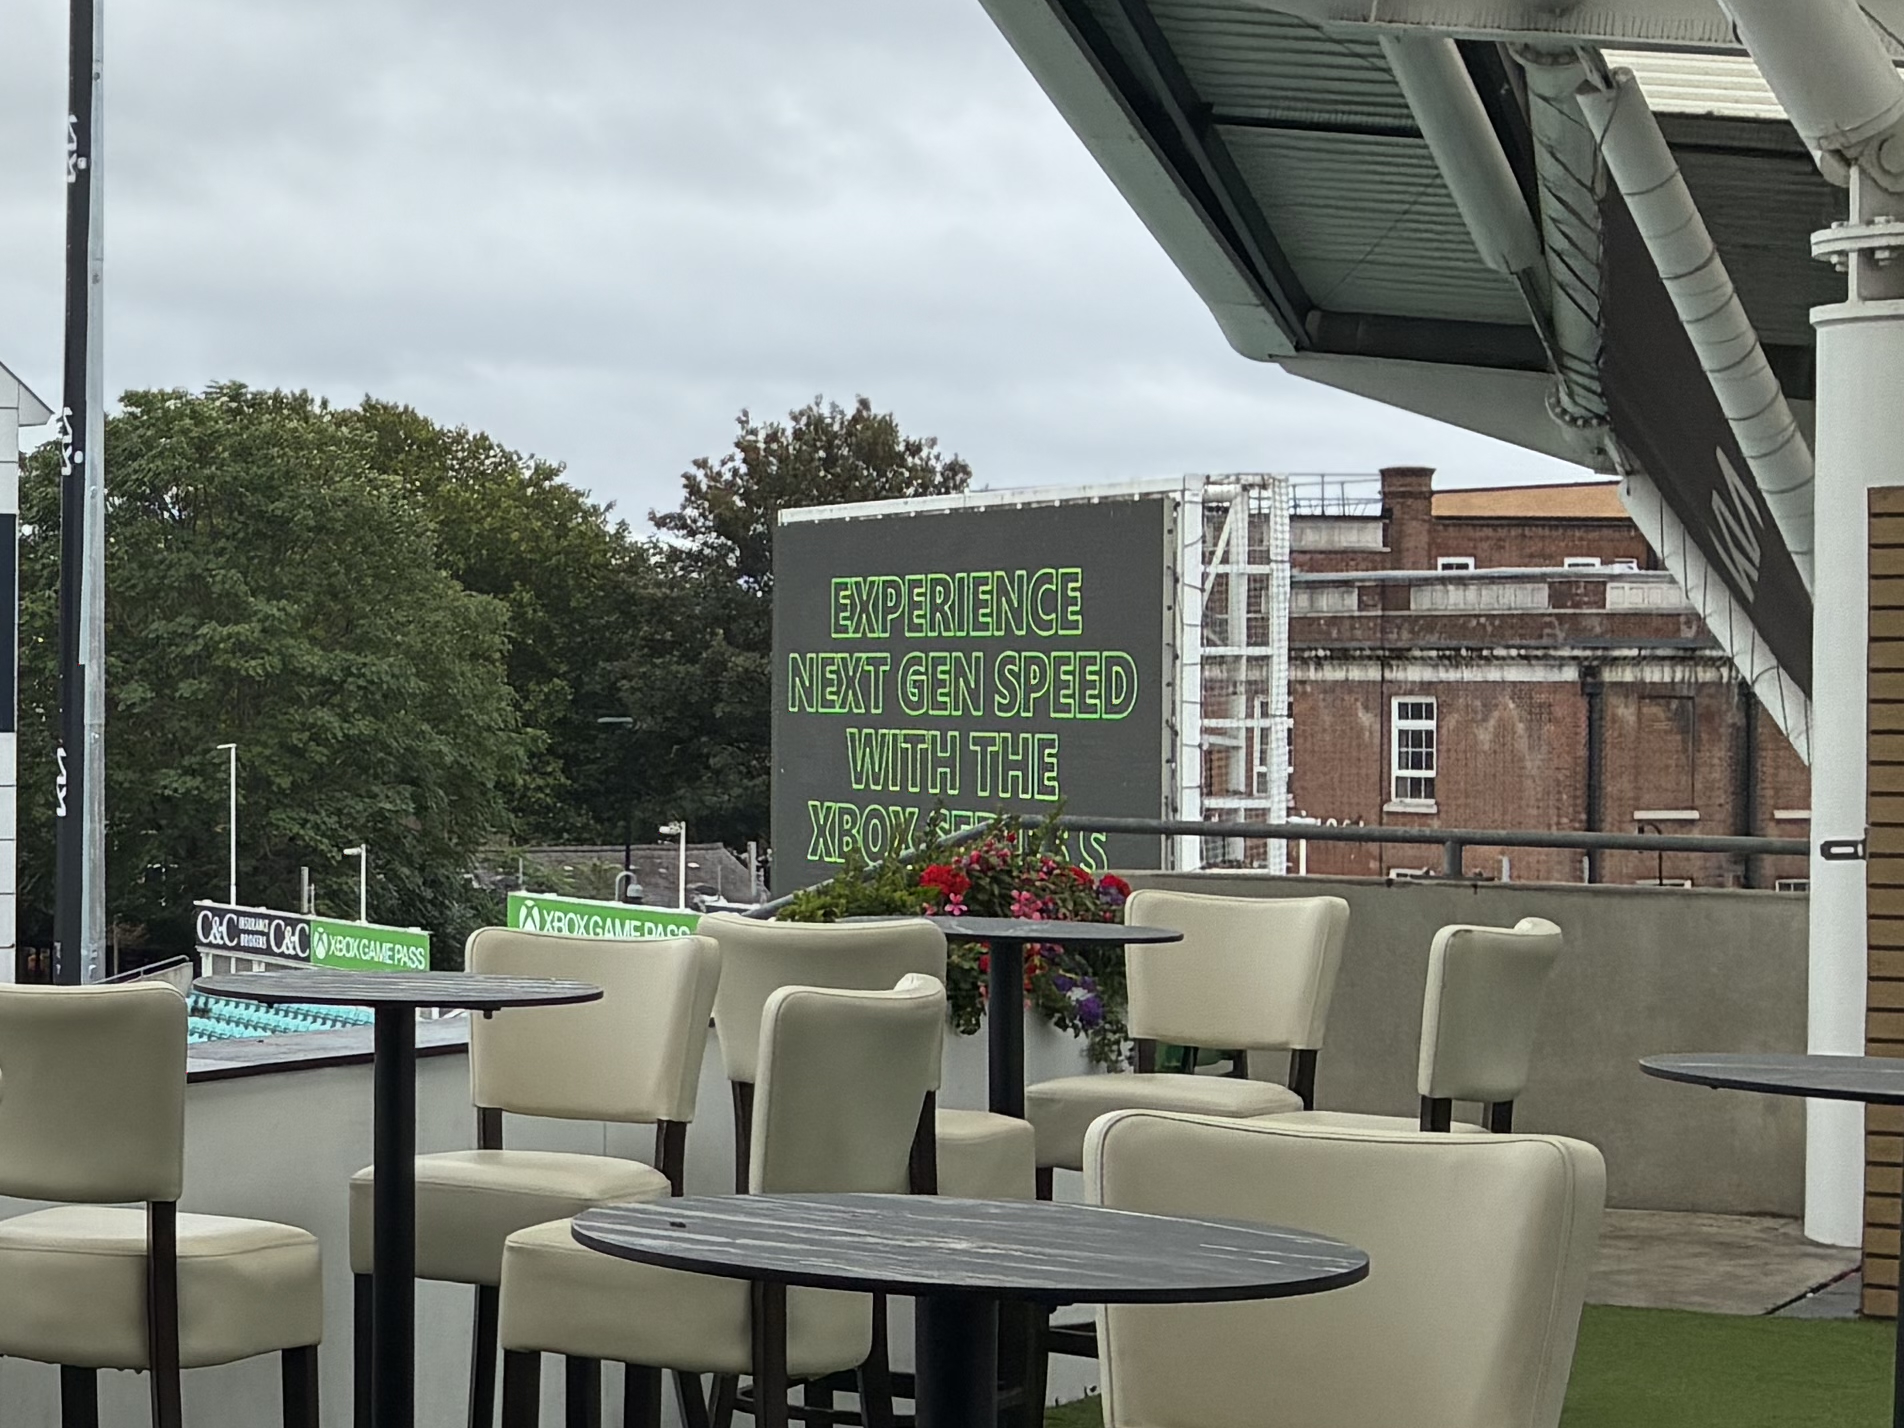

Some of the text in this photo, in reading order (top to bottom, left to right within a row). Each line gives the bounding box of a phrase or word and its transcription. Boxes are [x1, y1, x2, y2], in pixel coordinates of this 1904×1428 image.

[831, 567, 1082, 639] EXPERIENCE
[789, 650, 1138, 719] NEXT GEN SPEED
[846, 728, 1058, 800] WITH THE
[807, 800, 919, 868] XBOX
[196, 910, 309, 958] C&C C&C
[328, 934, 425, 970] XBOX GAME PASS
[543, 909, 589, 936] XBOX
